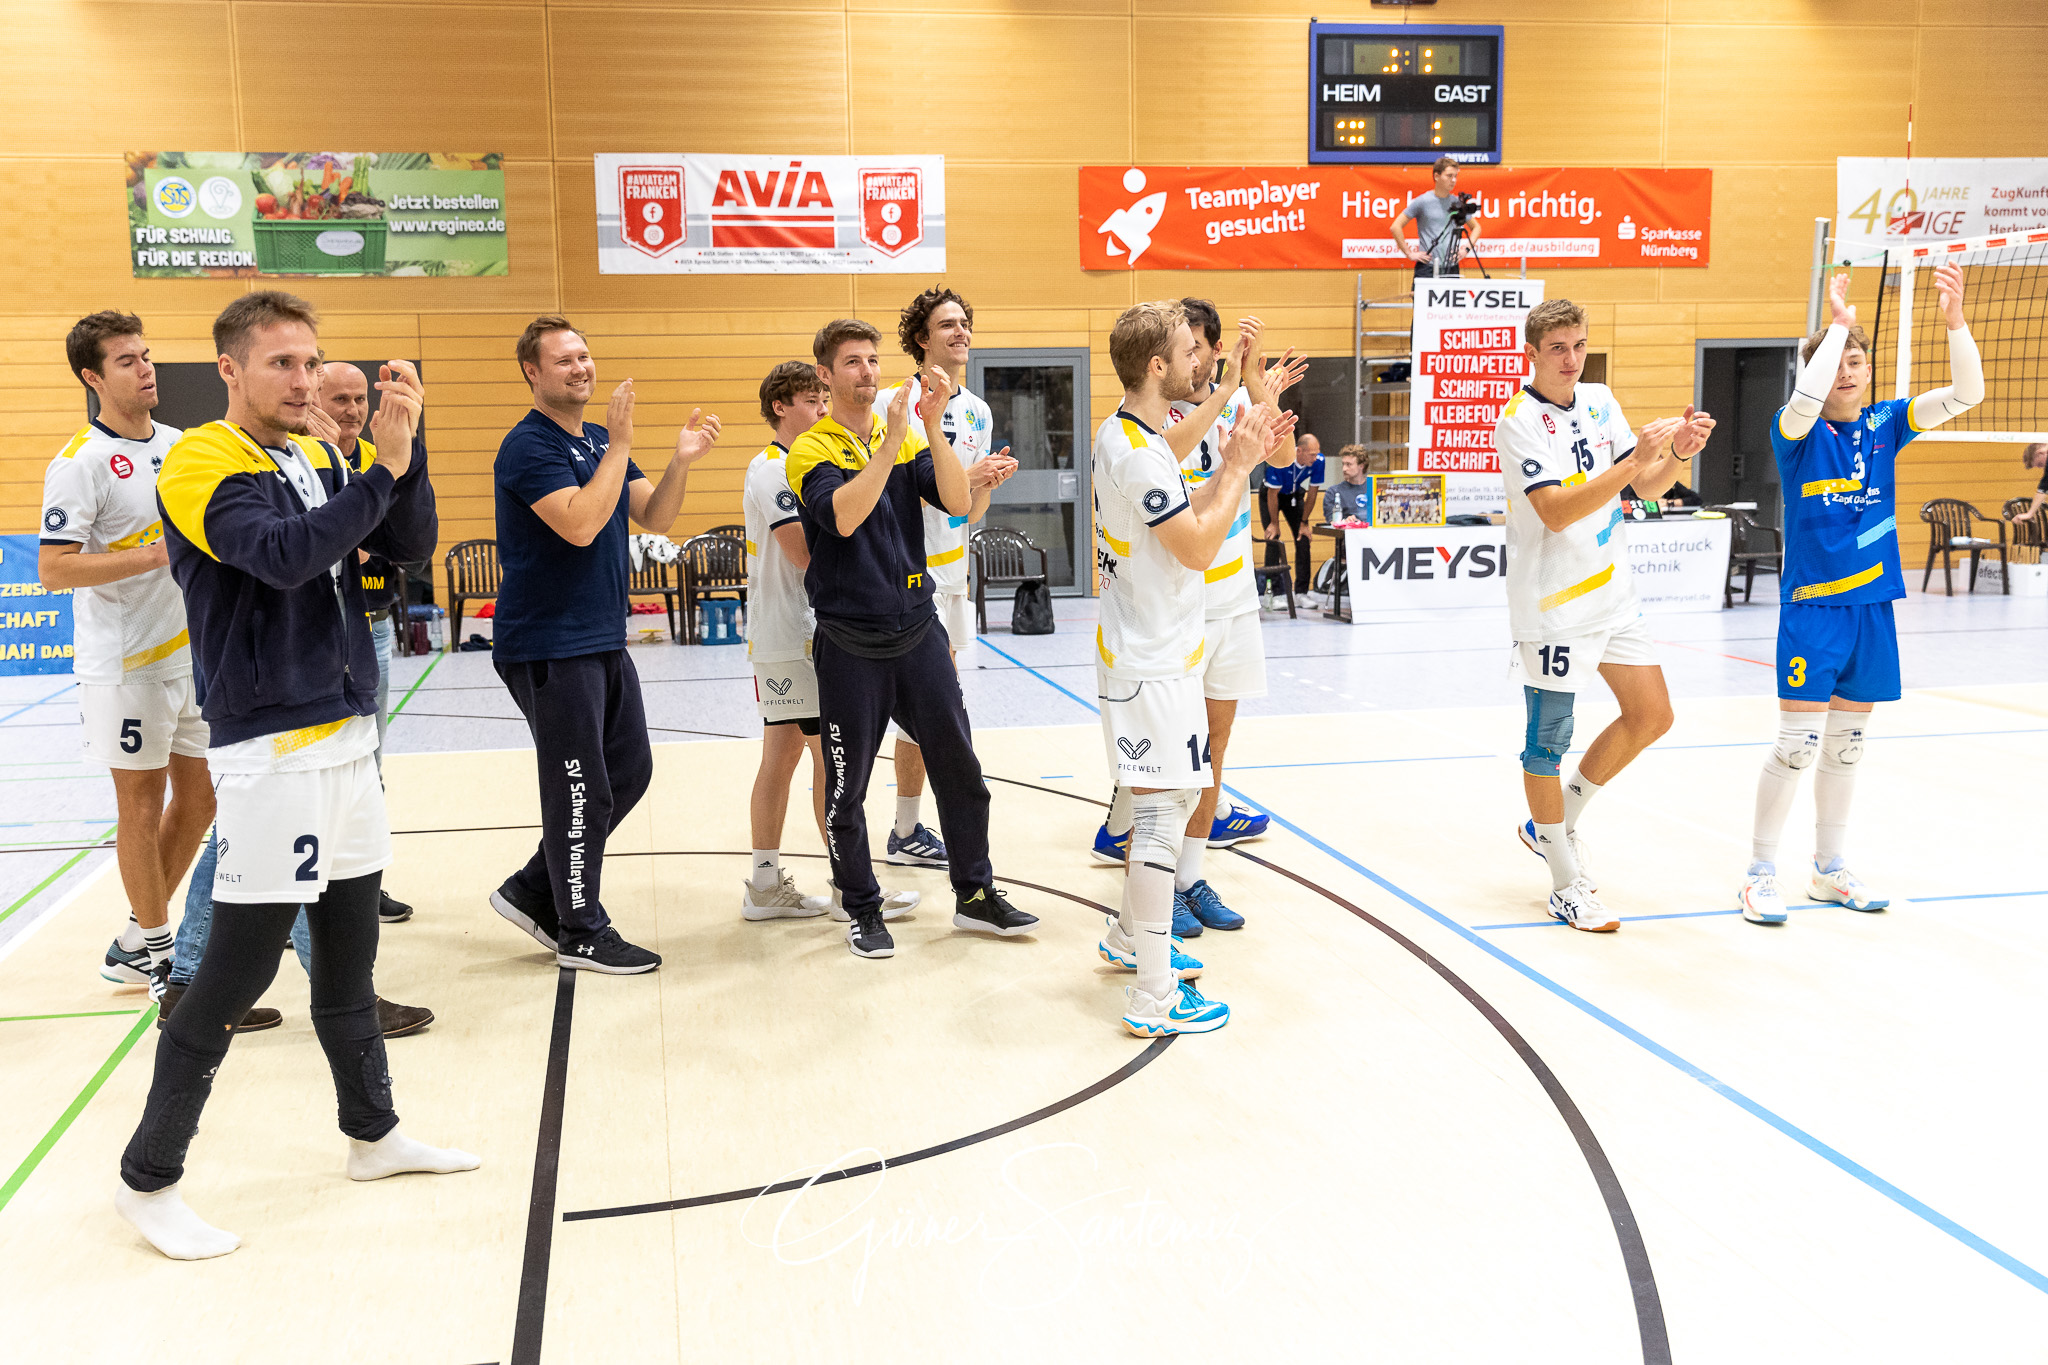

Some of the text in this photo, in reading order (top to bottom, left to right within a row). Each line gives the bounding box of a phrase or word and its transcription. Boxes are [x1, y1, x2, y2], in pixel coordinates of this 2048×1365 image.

[1323, 84, 1491, 103] HEIM GAST
[626, 174, 677, 188] #AVIATEAM
[866, 175, 915, 189] #AVIATEAM
[389, 193, 499, 211] Jetzt bestellen
[626, 186, 678, 200] FRANKEN
[866, 187, 916, 200] FRANKEN
[1185, 180, 1320, 212] Teamplayer
[1921, 187, 1971, 203] JAHRE
[1342, 190, 1400, 218] Hier
[1508, 189, 1602, 225] richtig.
[1848, 188, 1918, 234] 40
[1984, 205, 2048, 217] kommt vo
[390, 217, 506, 236] www.regineo.de
[1206, 209, 1306, 245] gesucht!
[1924, 211, 1966, 234] IGE
[136, 227, 235, 245] FÜR SCHWAIG.
[1641, 228, 1702, 243] Sparkasse
[138, 249, 257, 267] FÜR DIE REGION.
[1641, 244, 1698, 260] Nürnberg
[1428, 290, 1530, 308] MEYSEL
[1427, 311, 1453, 320] Druck
[1443, 329, 1511, 350] SCHILDER
[1427, 354, 1523, 374] FOTOTAPETEN
[1440, 379, 1514, 399] SCHRIFTEN
[1423, 451, 1501, 470] BESCHRIFT
[1570, 437, 1595, 474] 15
[1850, 451, 1865, 480] 3
[1362, 545, 1506, 581] MEYS
[362, 576, 385, 590] MM
[907, 573, 923, 589] FT
[1538, 645, 1570, 678] 15
[1787, 656, 1807, 688] 3
[119, 718, 143, 755] 5
[829, 723, 841, 743] SV
[1187, 733, 1214, 772] 14
[564, 759, 587, 910] SV Schwaig Volleyball
[293, 834, 319, 882] 2
